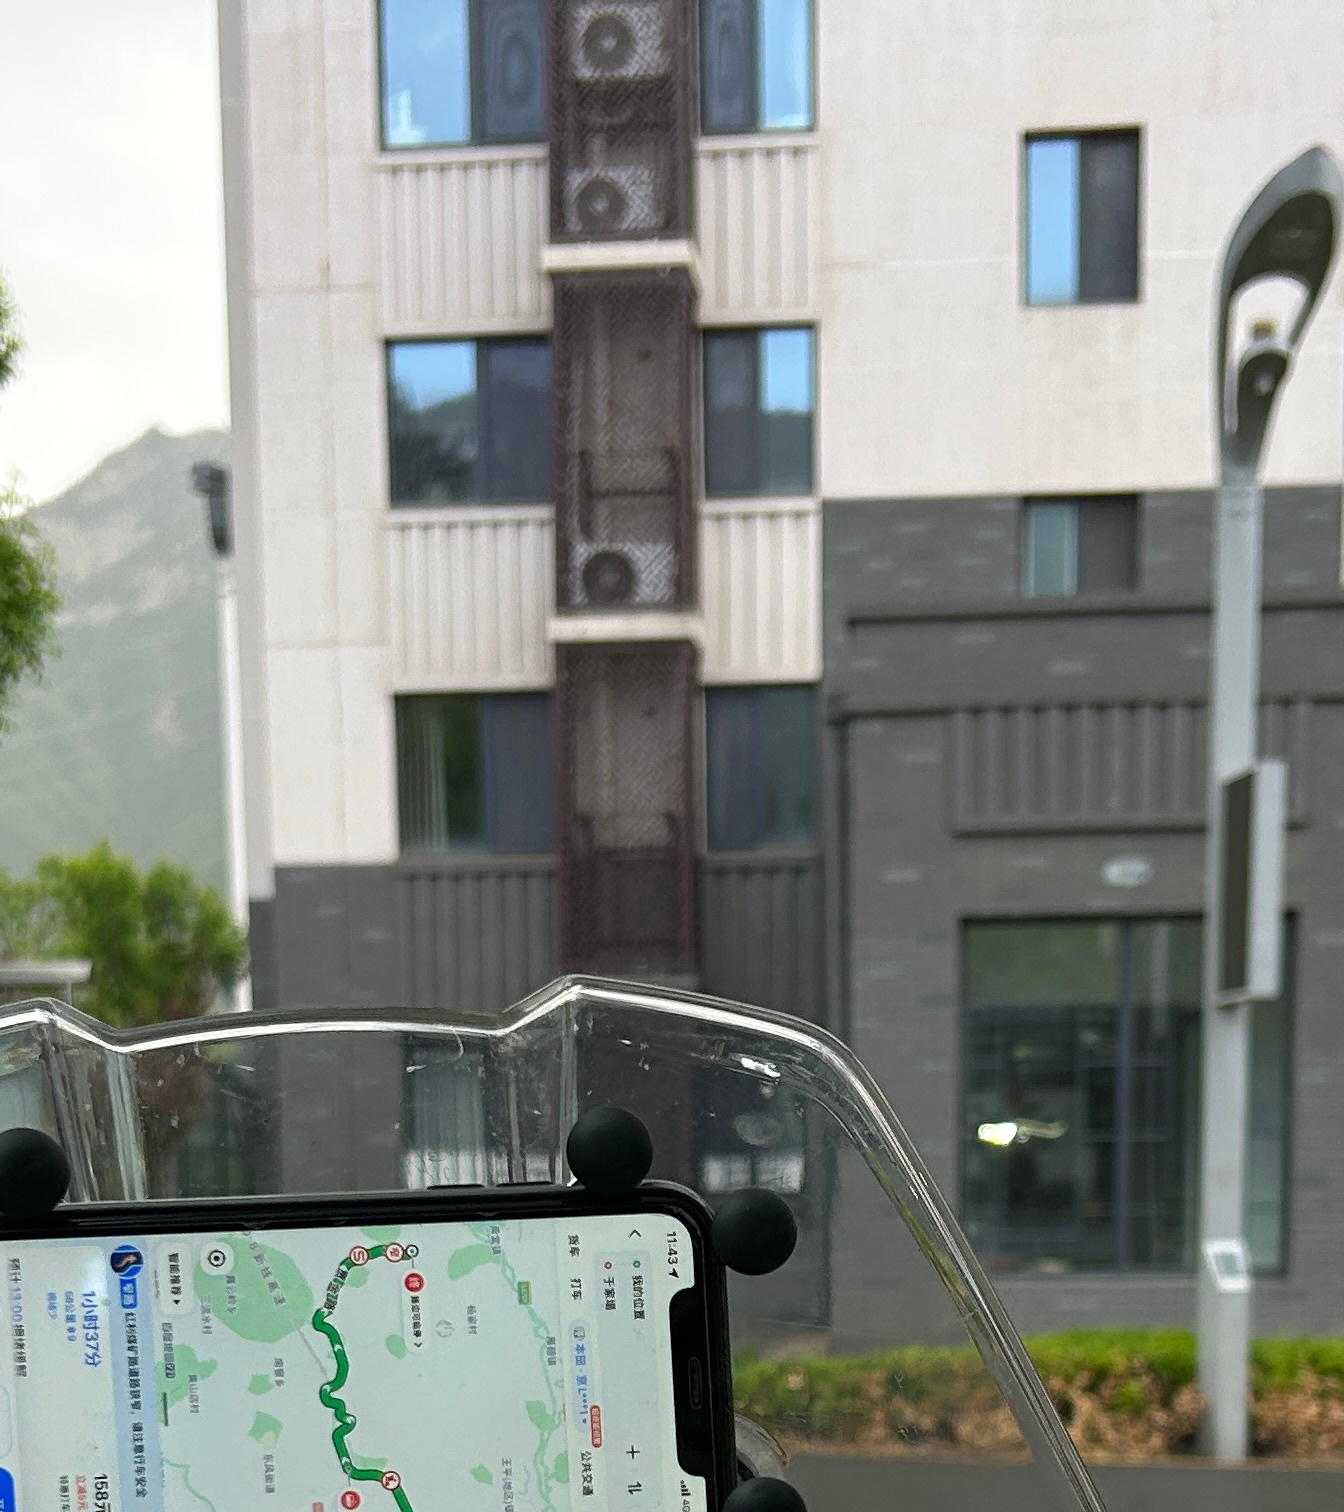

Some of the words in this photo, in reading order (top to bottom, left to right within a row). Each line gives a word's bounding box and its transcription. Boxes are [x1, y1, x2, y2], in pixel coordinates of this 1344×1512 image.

[666, 1232, 678, 1265] 11:43
[169, 1253, 182, 1296] 智能推荐
[571, 1278, 582, 1301] 打车
[632, 1276, 645, 1320] 我的位置
[82, 1291, 100, 1367] 1小时37分
[575, 1344, 586, 1366] 本田
[581, 1451, 594, 1496] 公共交通
[682, 1499, 691, 1512] 4G
